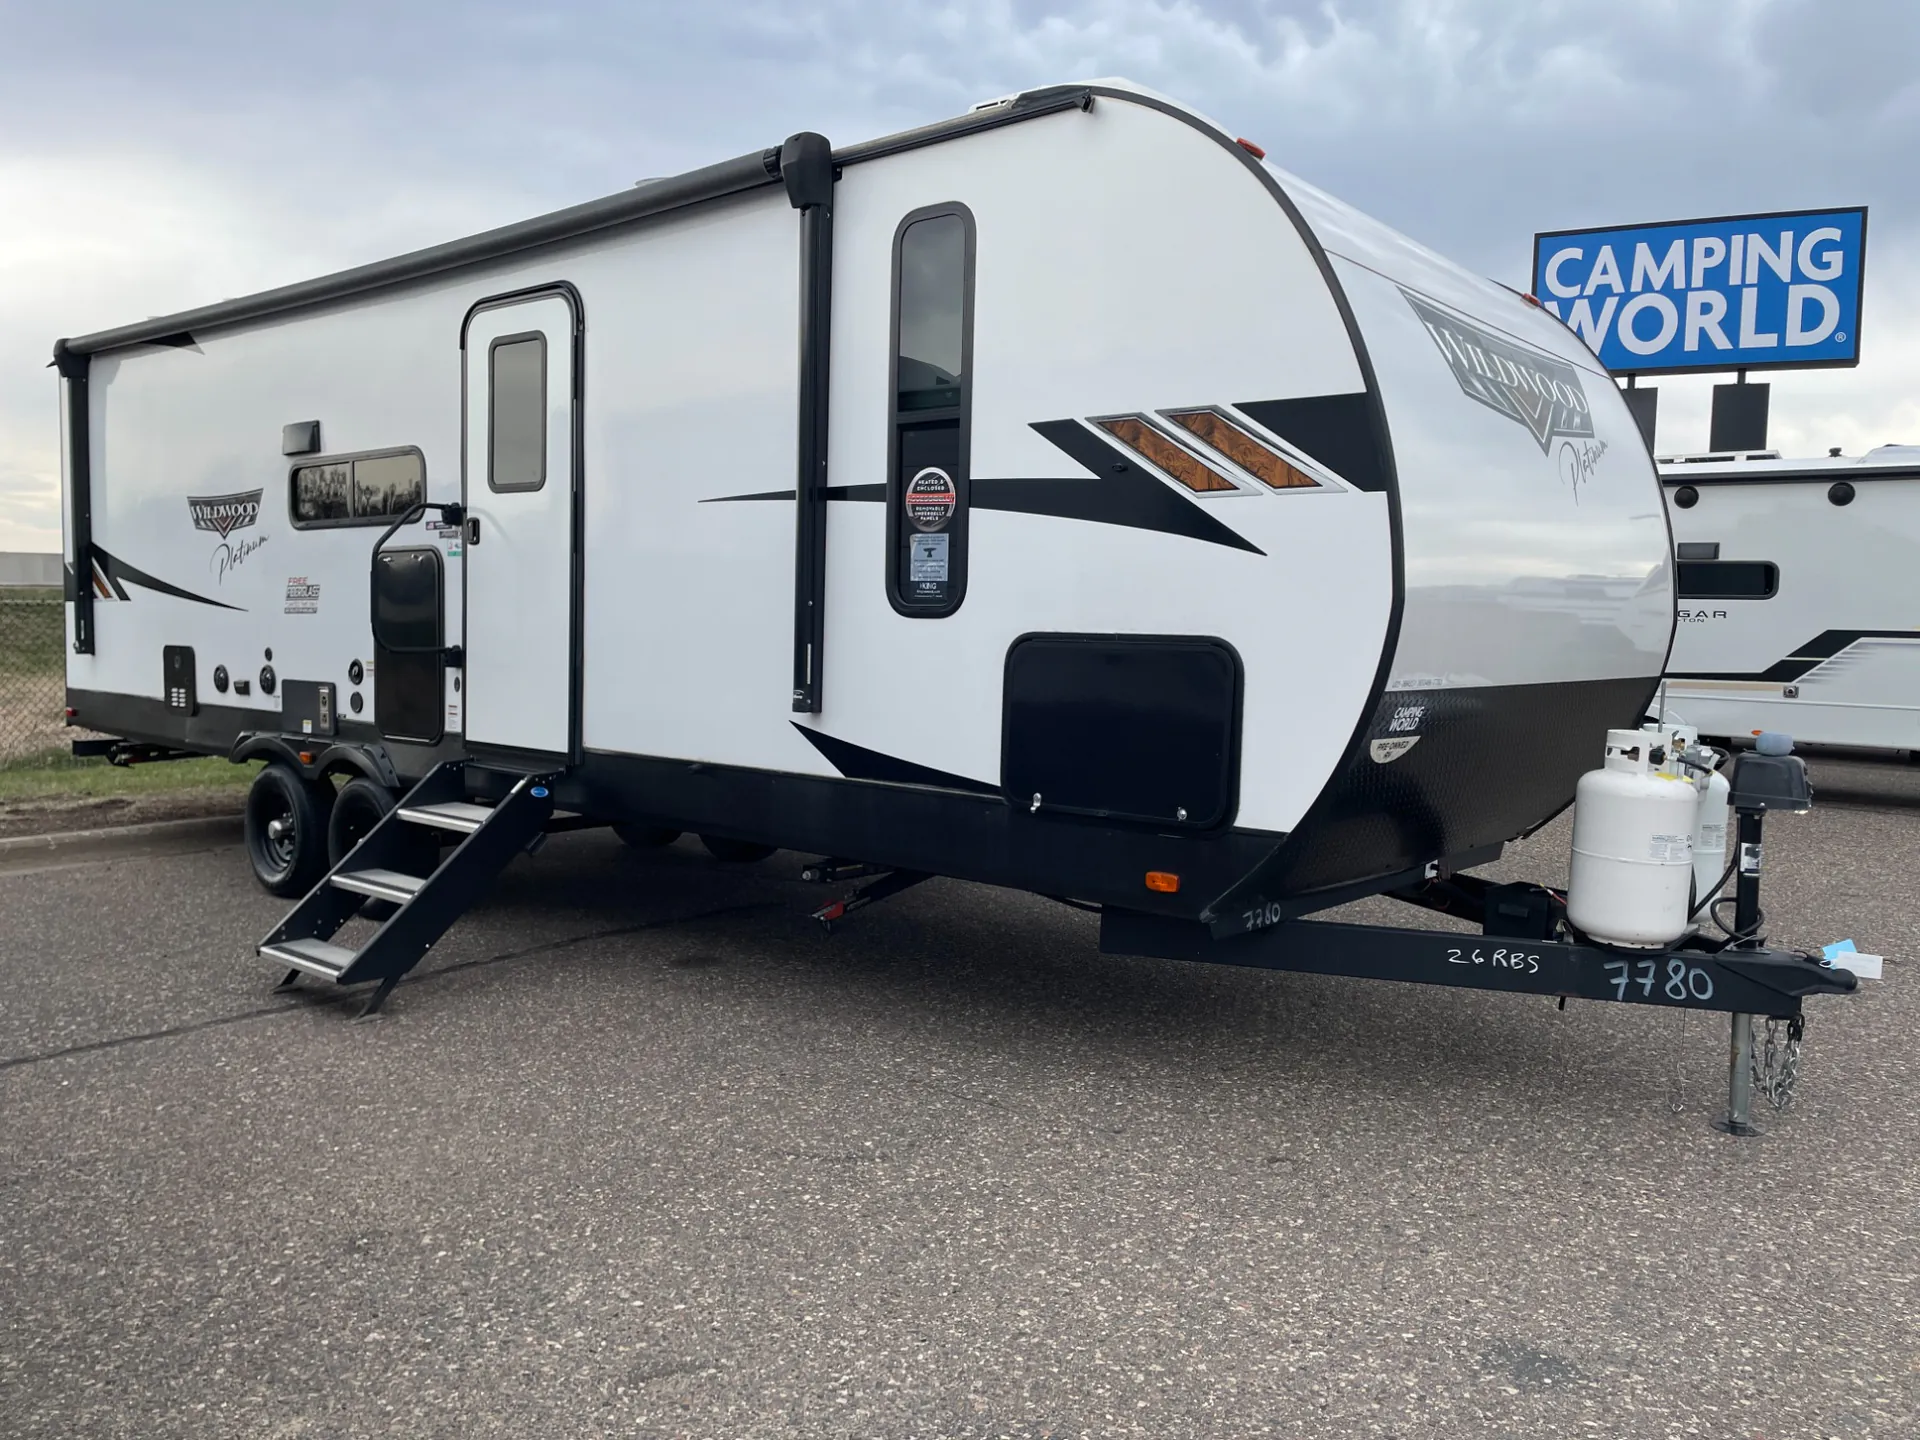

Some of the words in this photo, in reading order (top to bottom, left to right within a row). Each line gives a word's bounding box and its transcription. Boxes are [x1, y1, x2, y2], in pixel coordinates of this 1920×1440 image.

[1545, 227, 1843, 299] CAMPING
[1544, 284, 1841, 356] WORLD
[1424, 321, 1589, 415] WILDWOOD
[1558, 440, 1609, 507] Platinum
[190, 502, 259, 520] WILDWOOD
[209, 534, 270, 587] Platinum
[1388, 717, 1420, 732] WORLD
[1394, 706, 1425, 718] CAMPING
[1603, 958, 1714, 1001] 7780
